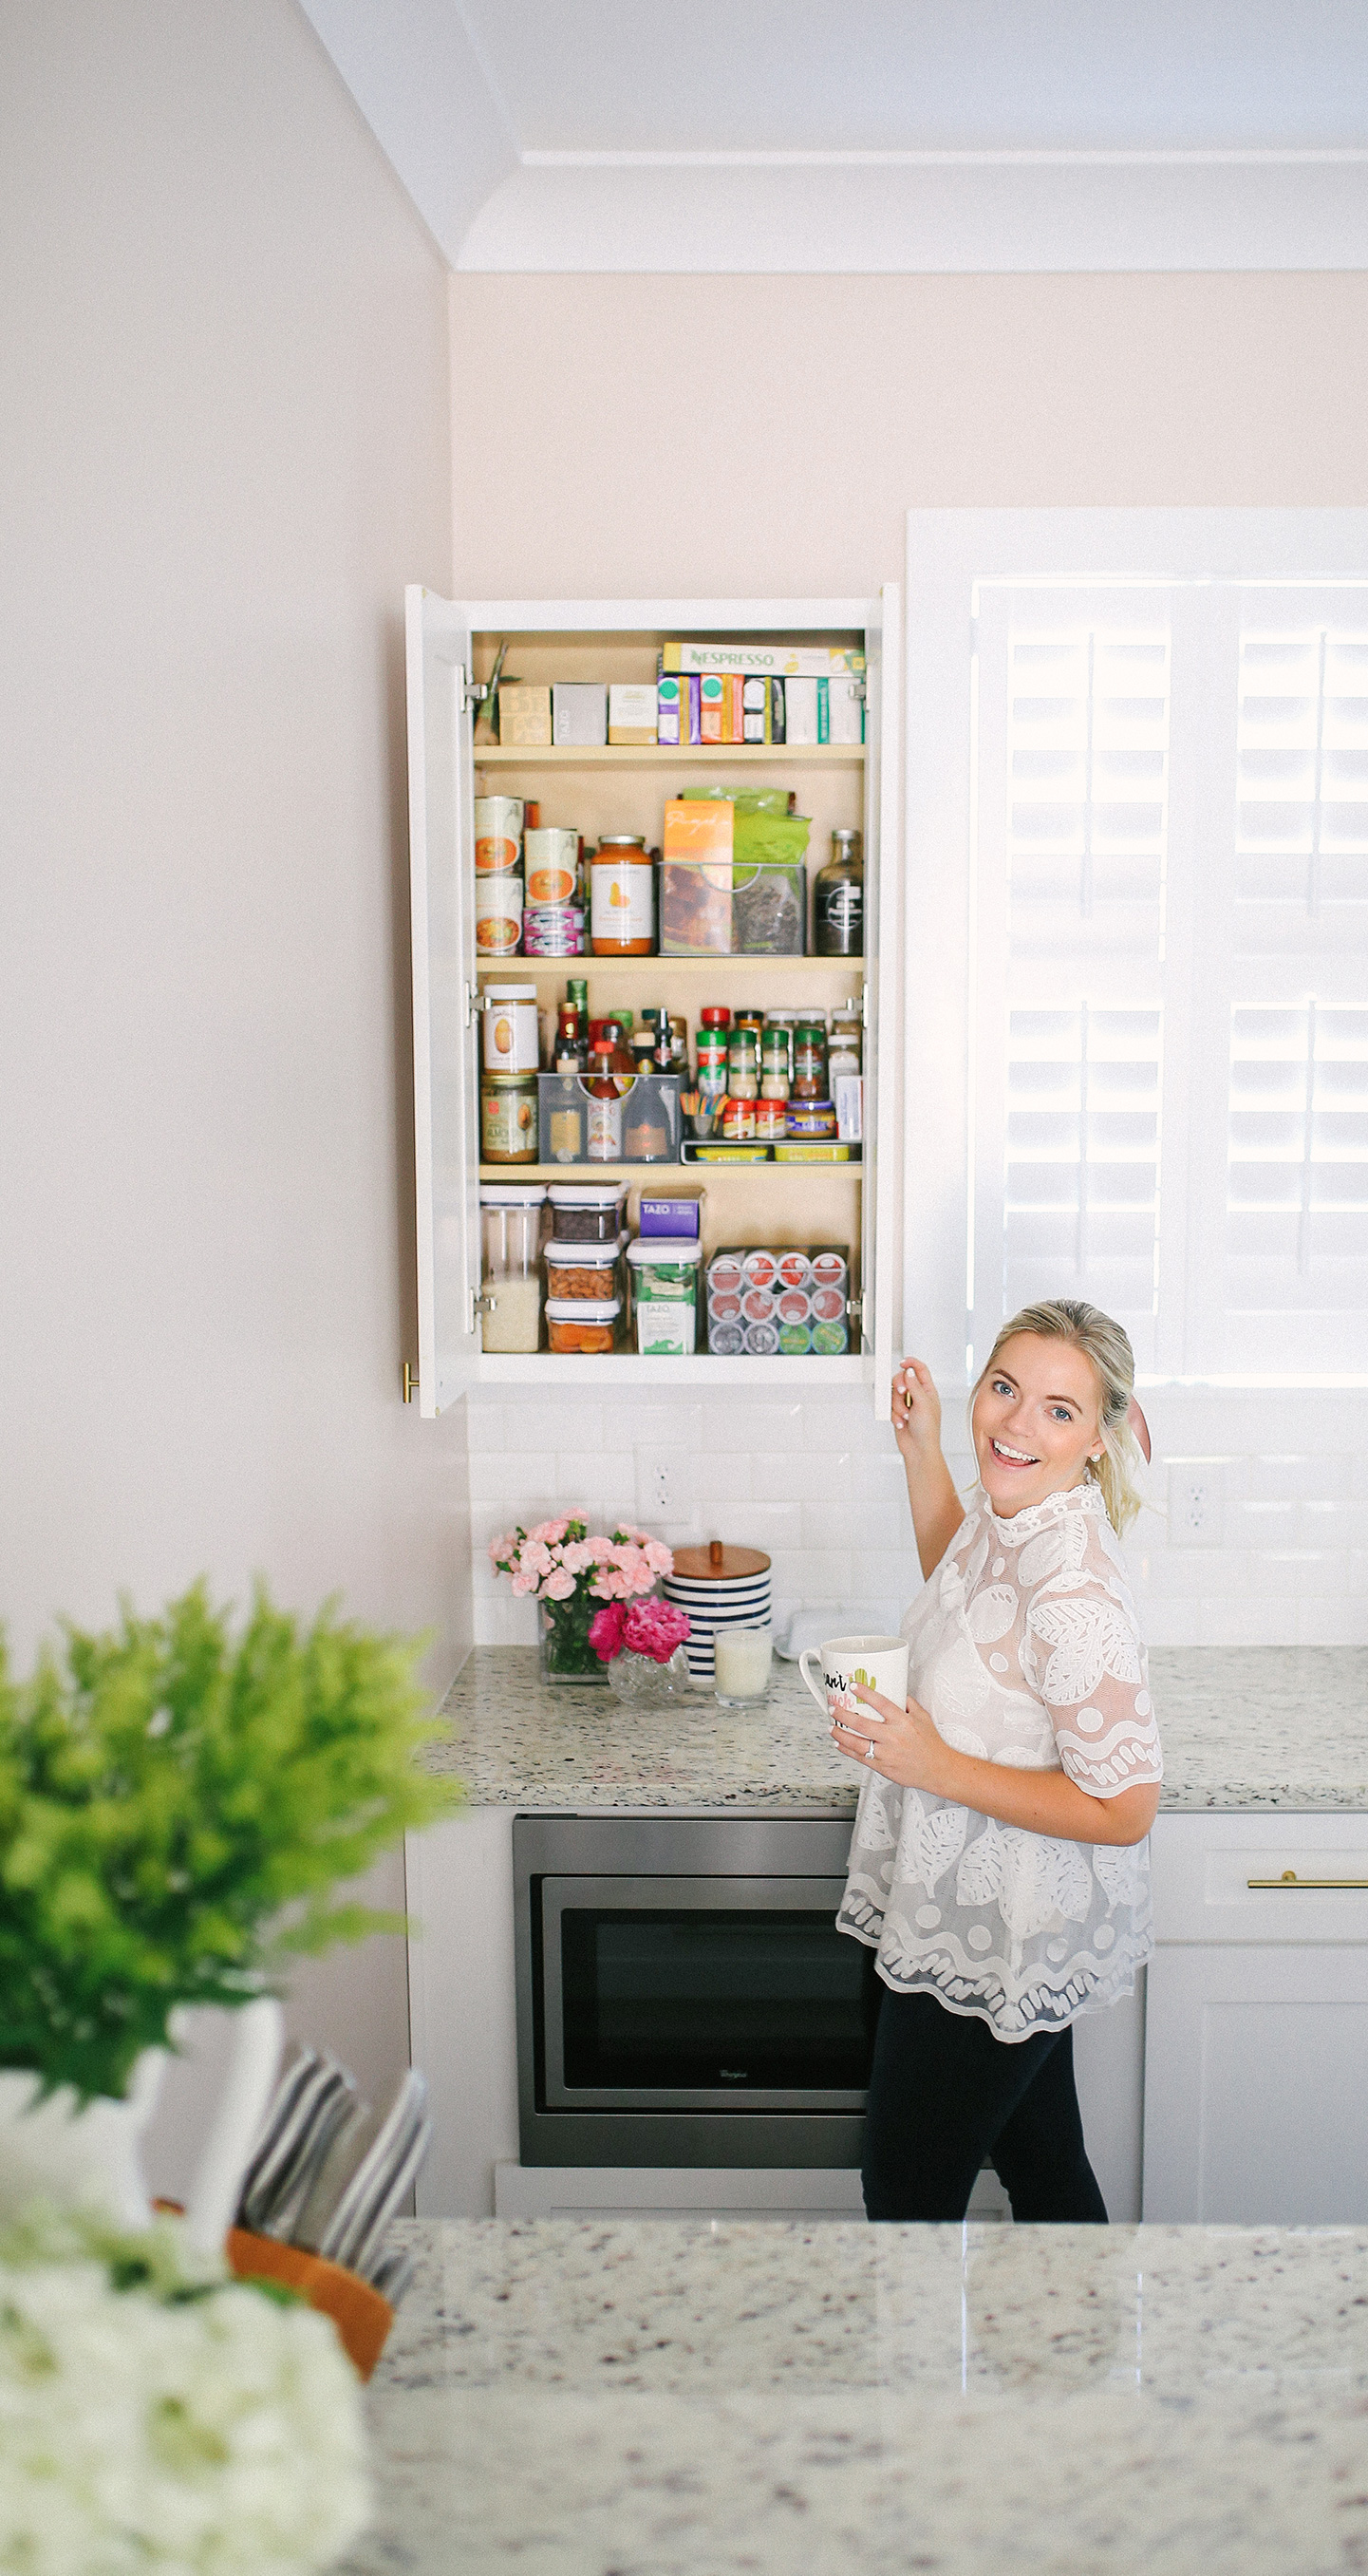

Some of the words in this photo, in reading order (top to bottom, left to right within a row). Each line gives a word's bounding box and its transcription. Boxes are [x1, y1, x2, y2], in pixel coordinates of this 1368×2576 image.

[690, 649, 775, 667] NESPRESSO
[643, 1203, 670, 1215] TAZO
[645, 1304, 670, 1314] TAZO
